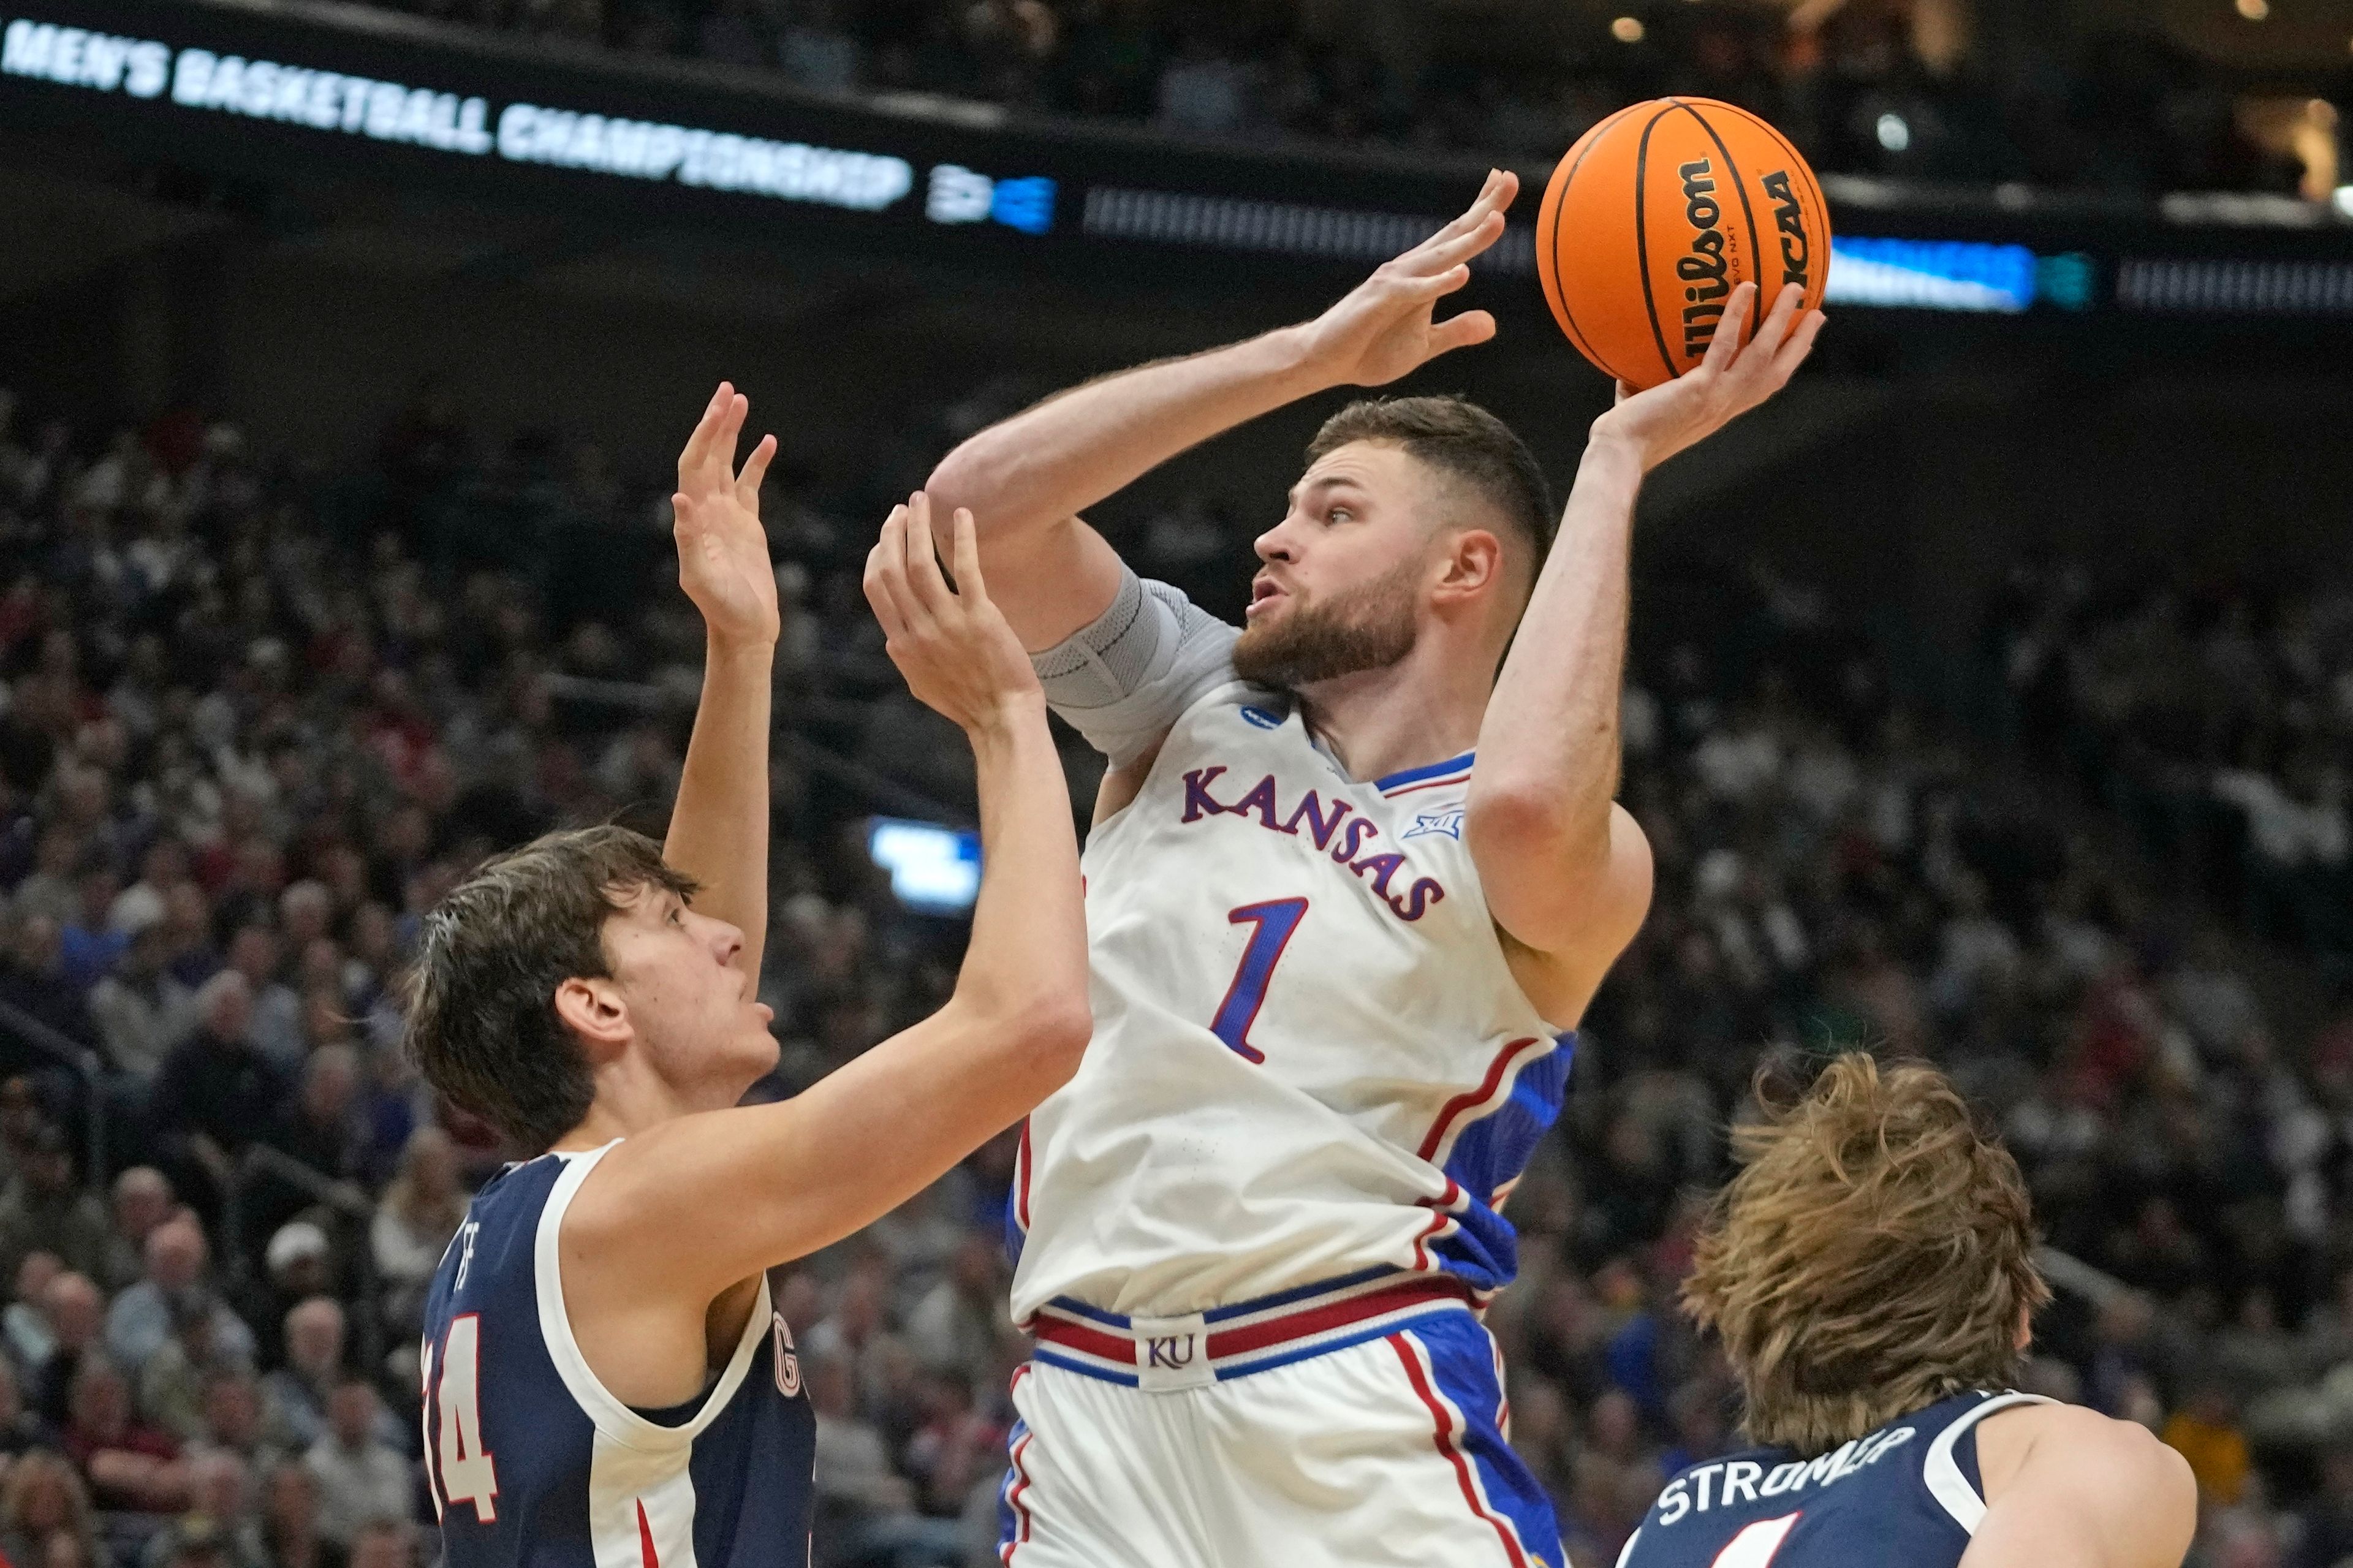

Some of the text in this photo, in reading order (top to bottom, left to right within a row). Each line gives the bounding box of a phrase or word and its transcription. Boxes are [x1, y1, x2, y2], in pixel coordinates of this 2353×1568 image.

[2, 19, 172, 99] MEN'S
[171, 48, 493, 155] BASKETBALL
[499, 103, 913, 211] CHAMPIONSHIP
[1727, 225, 1737, 252] NXT
[1181, 766, 1445, 922] KANSAS
[1208, 896, 1309, 1065] 1
[1146, 1333, 1195, 1369] KU
[1658, 1426, 1916, 1526] STROMER
